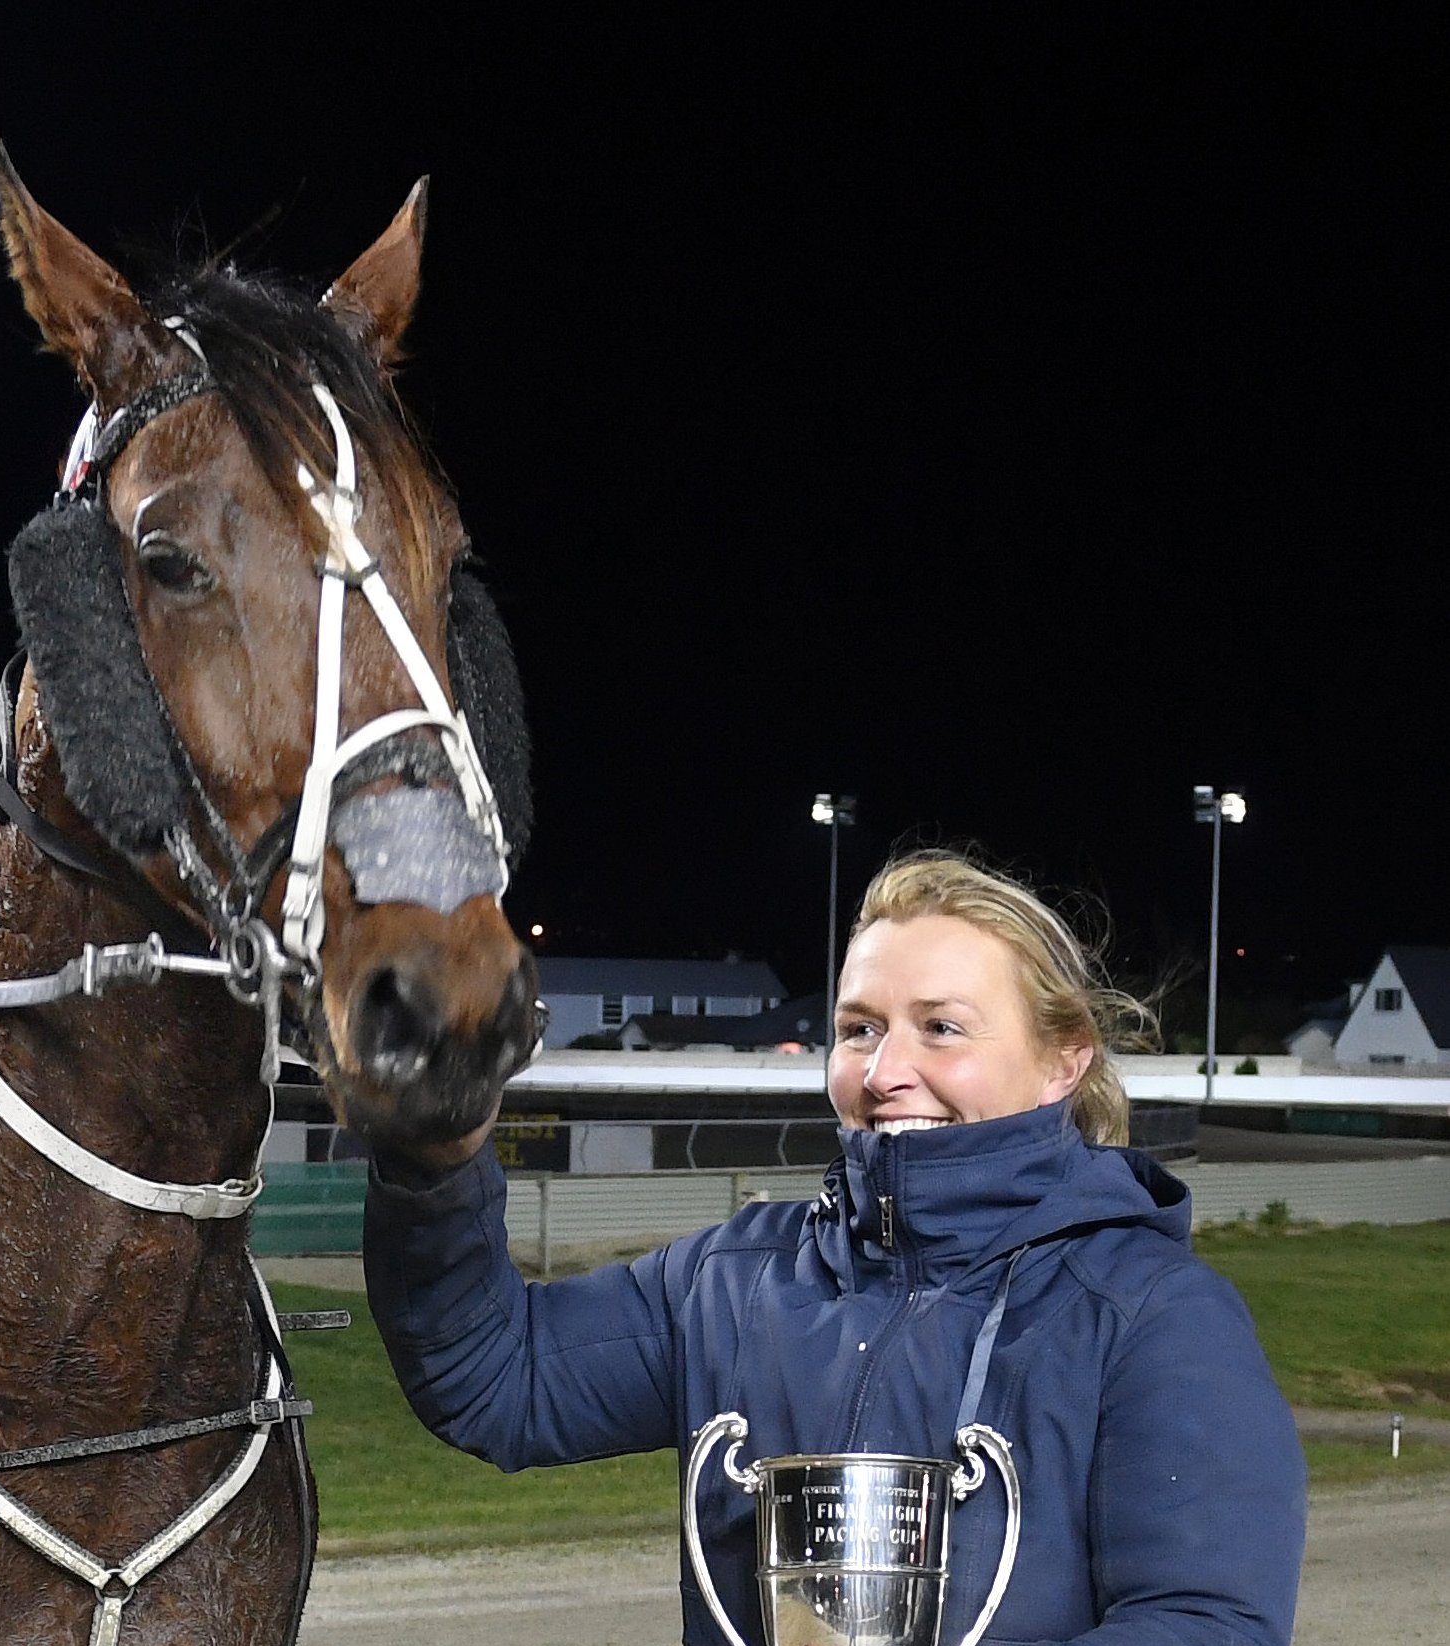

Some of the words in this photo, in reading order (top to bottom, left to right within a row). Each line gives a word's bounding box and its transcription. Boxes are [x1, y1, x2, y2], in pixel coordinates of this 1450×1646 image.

[817, 1502, 866, 1519] FINA
[878, 1504, 924, 1522] NIGHT
[815, 1526, 880, 1543] PACING
[889, 1528, 920, 1546] CUP
